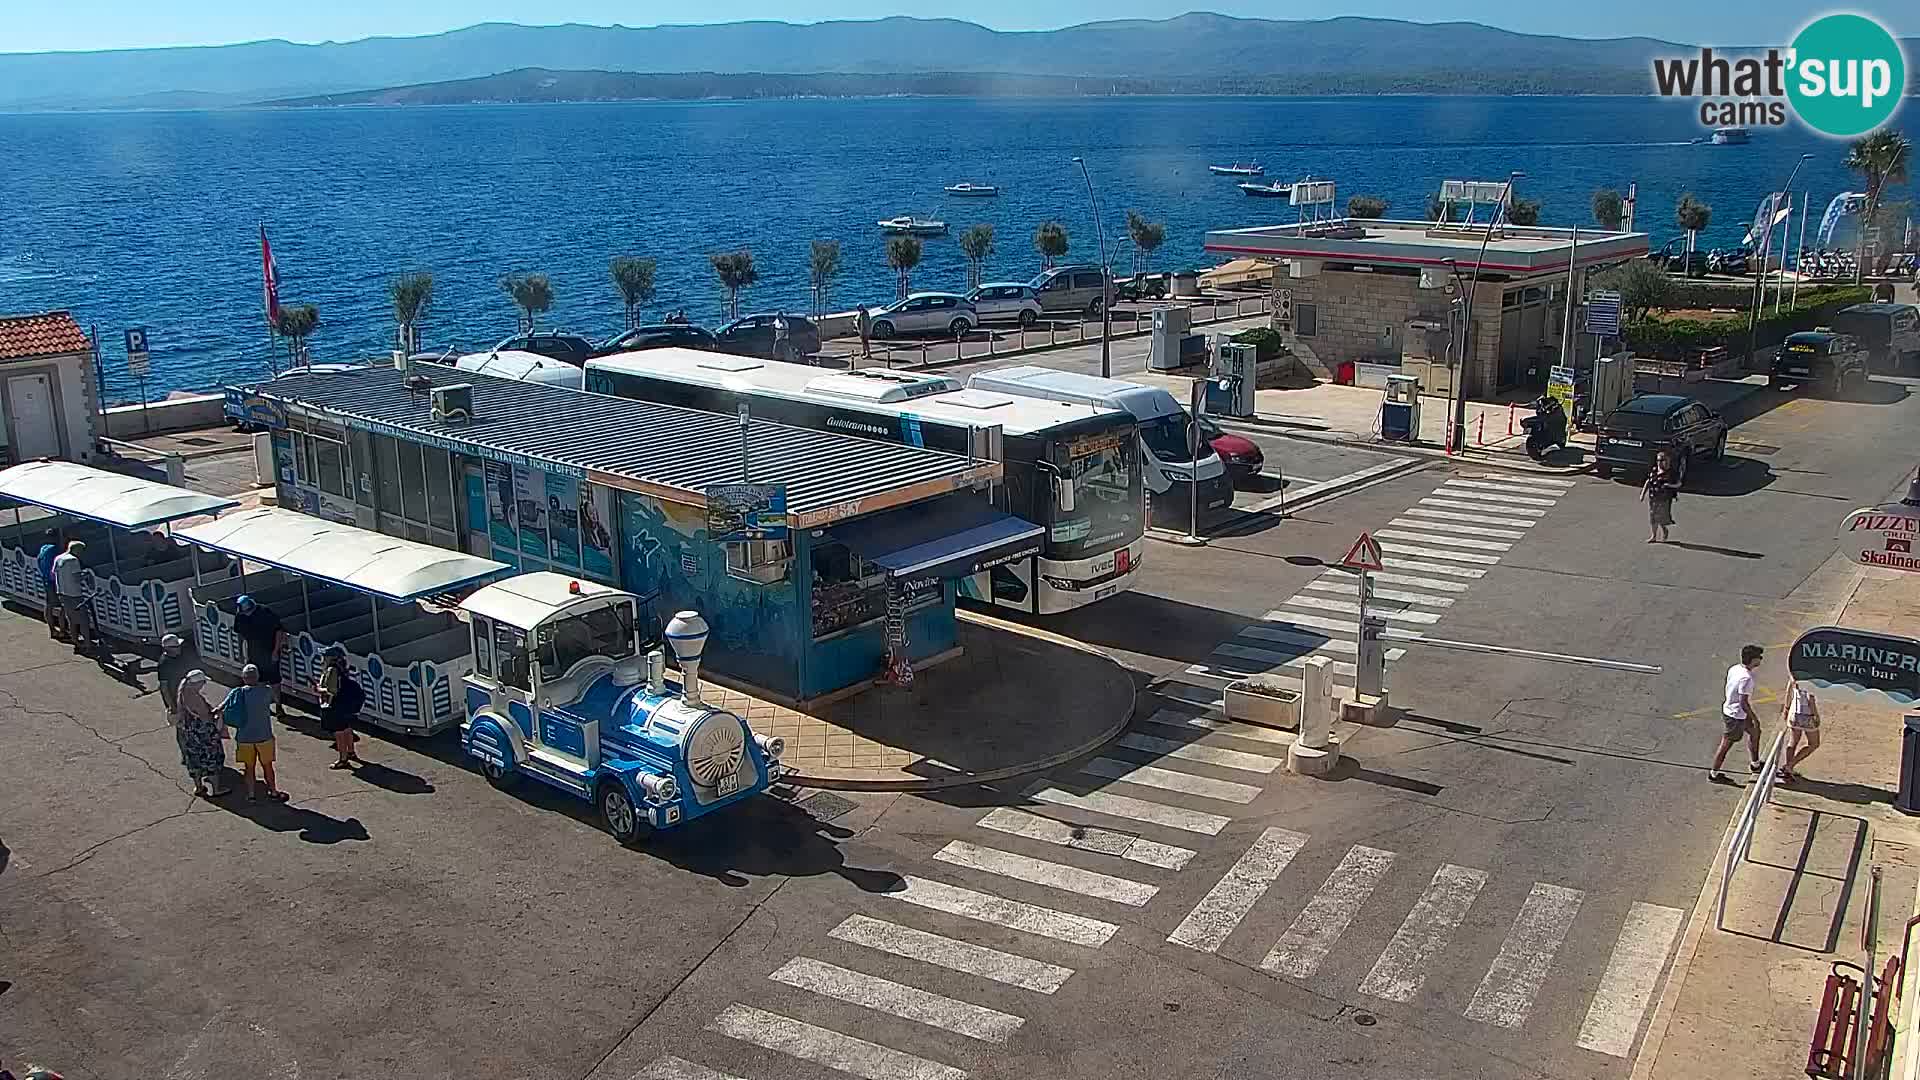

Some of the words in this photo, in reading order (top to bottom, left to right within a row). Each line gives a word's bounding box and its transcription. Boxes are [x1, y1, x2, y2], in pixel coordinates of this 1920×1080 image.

[130, 332, 142, 350] P
[494, 450, 526, 465] STATION
[529, 458, 554, 472] TICKET
[555, 465, 582, 477] OFFICE
[1849, 515, 1920, 533] PIZZE
[1091, 559, 1114, 573] IVEC
[1801, 642, 1920, 675] MARINER
[1829, 662, 1866, 675] caffe
[1871, 666, 1899, 681] bar
